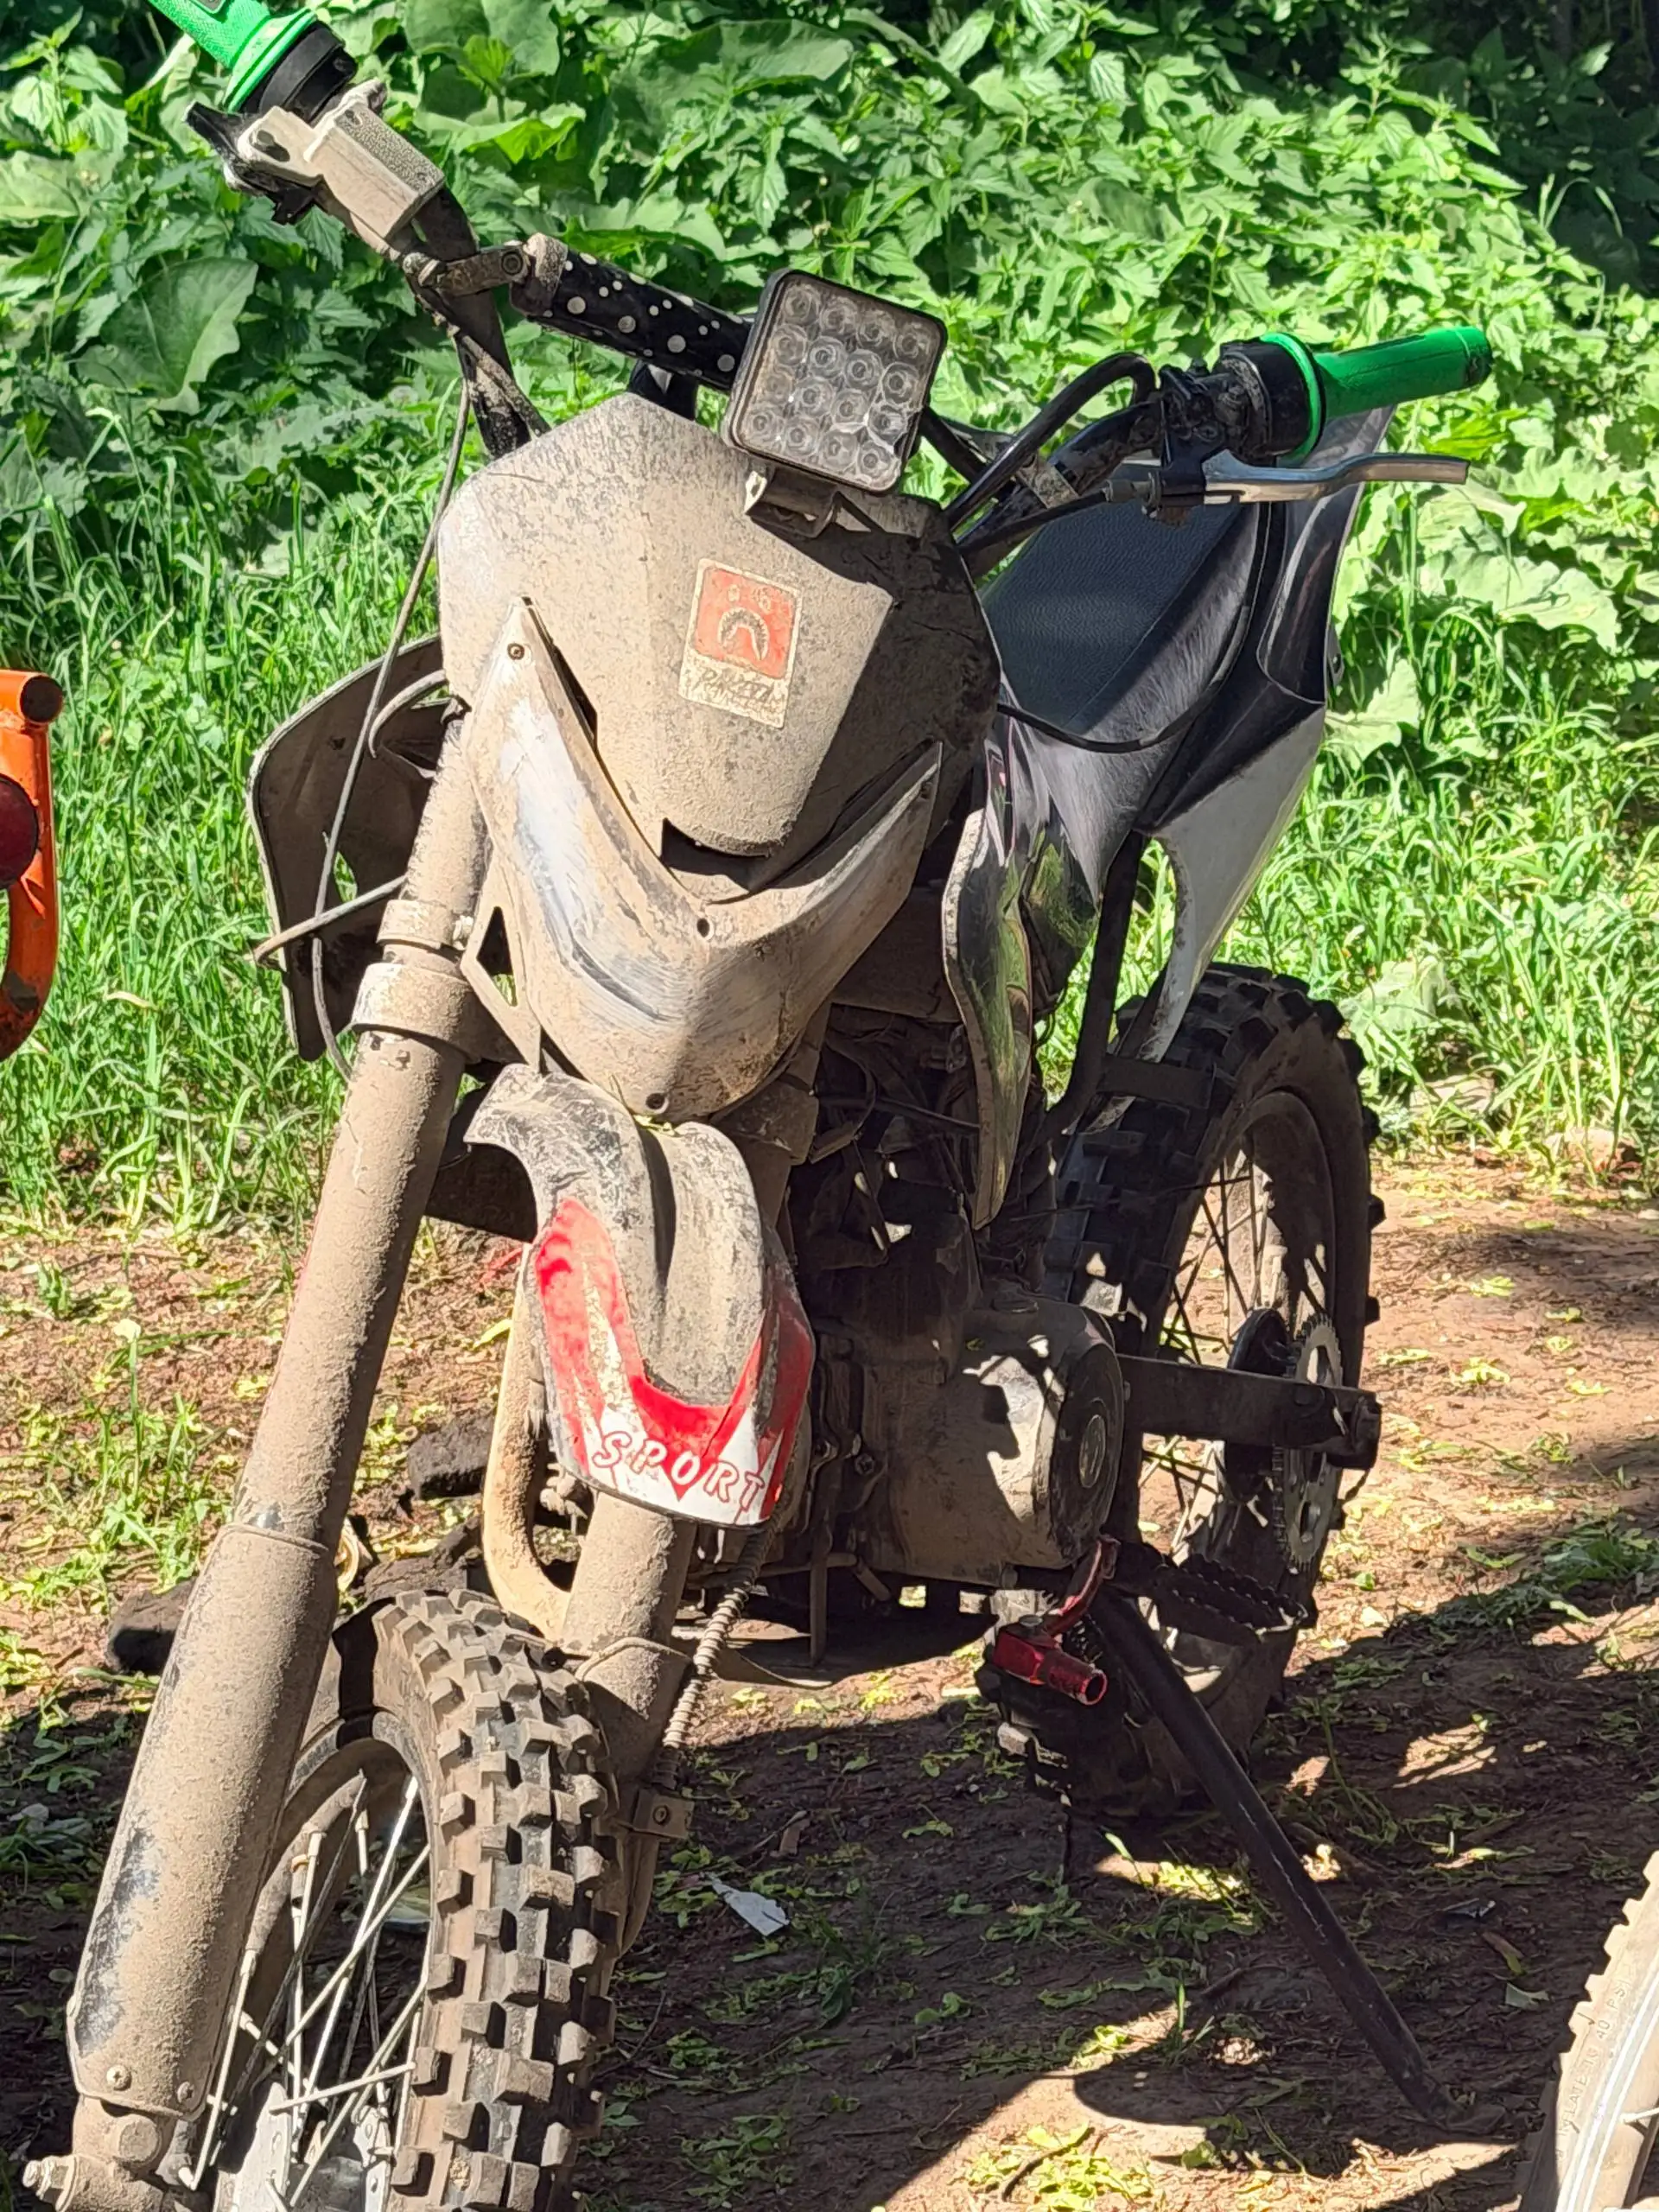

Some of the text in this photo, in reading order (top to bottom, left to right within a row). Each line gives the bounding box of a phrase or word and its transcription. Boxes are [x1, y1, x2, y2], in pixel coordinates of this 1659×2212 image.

[592, 1431, 765, 1510] SPORT
[1596, 2019, 1611, 2038] 40
[1606, 1978, 1631, 2010] PSI
